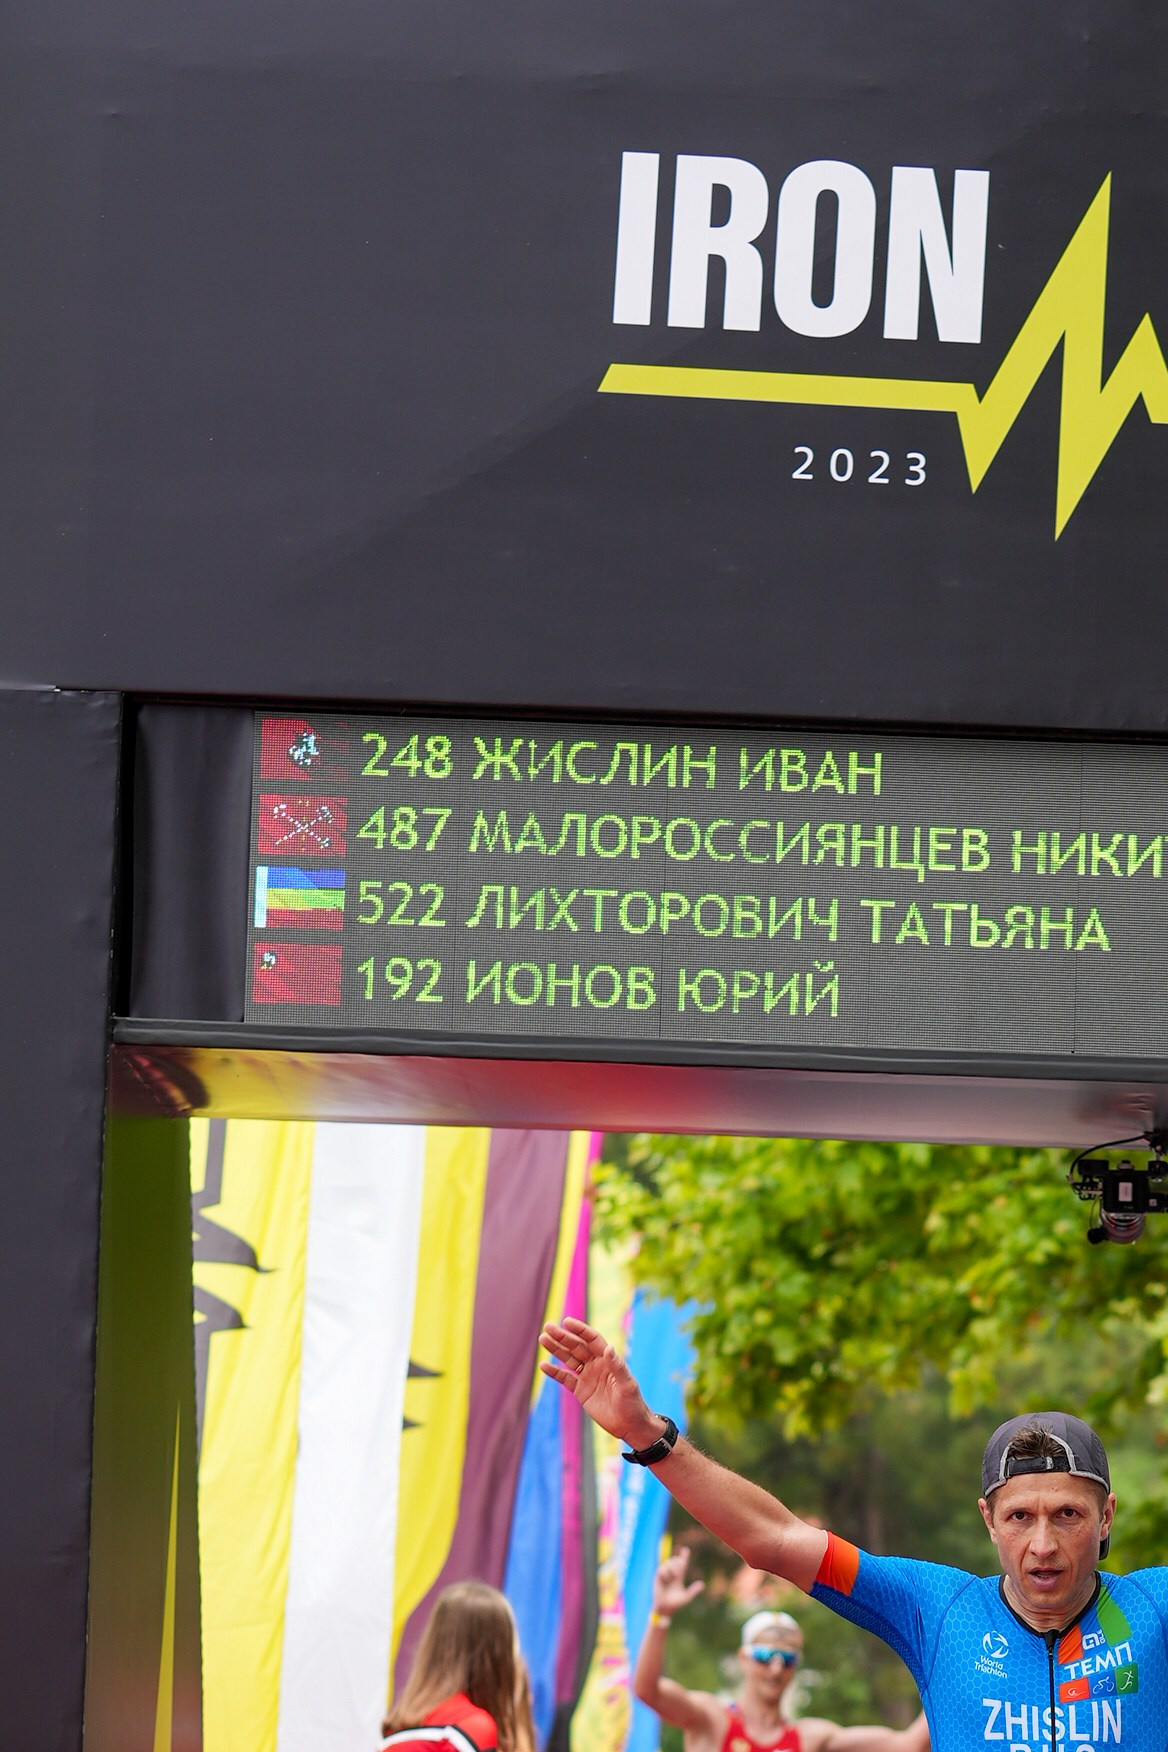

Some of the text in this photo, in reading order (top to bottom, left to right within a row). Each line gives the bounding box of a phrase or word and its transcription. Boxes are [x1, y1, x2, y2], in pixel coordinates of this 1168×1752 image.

[612, 151, 991, 344] IRON
[791, 446, 927, 487] 2023
[362, 733, 883, 795] 248 ЖИСЛИН ИВАН
[357, 806, 452, 851] 487
[468, 809, 991, 881] МАЛОРОССИЯНЦЕВ
[357, 880, 1112, 951] 522 ЛИХТОРОВИЧ ТАТЬЯНА
[357, 956, 840, 1017] 192 ИОНОВ ЮРИЙ
[974, 1661, 1009, 1679] Triathlon
[979, 1654, 1004, 1670] World
[982, 1698, 1122, 1744] ZHISLIN
